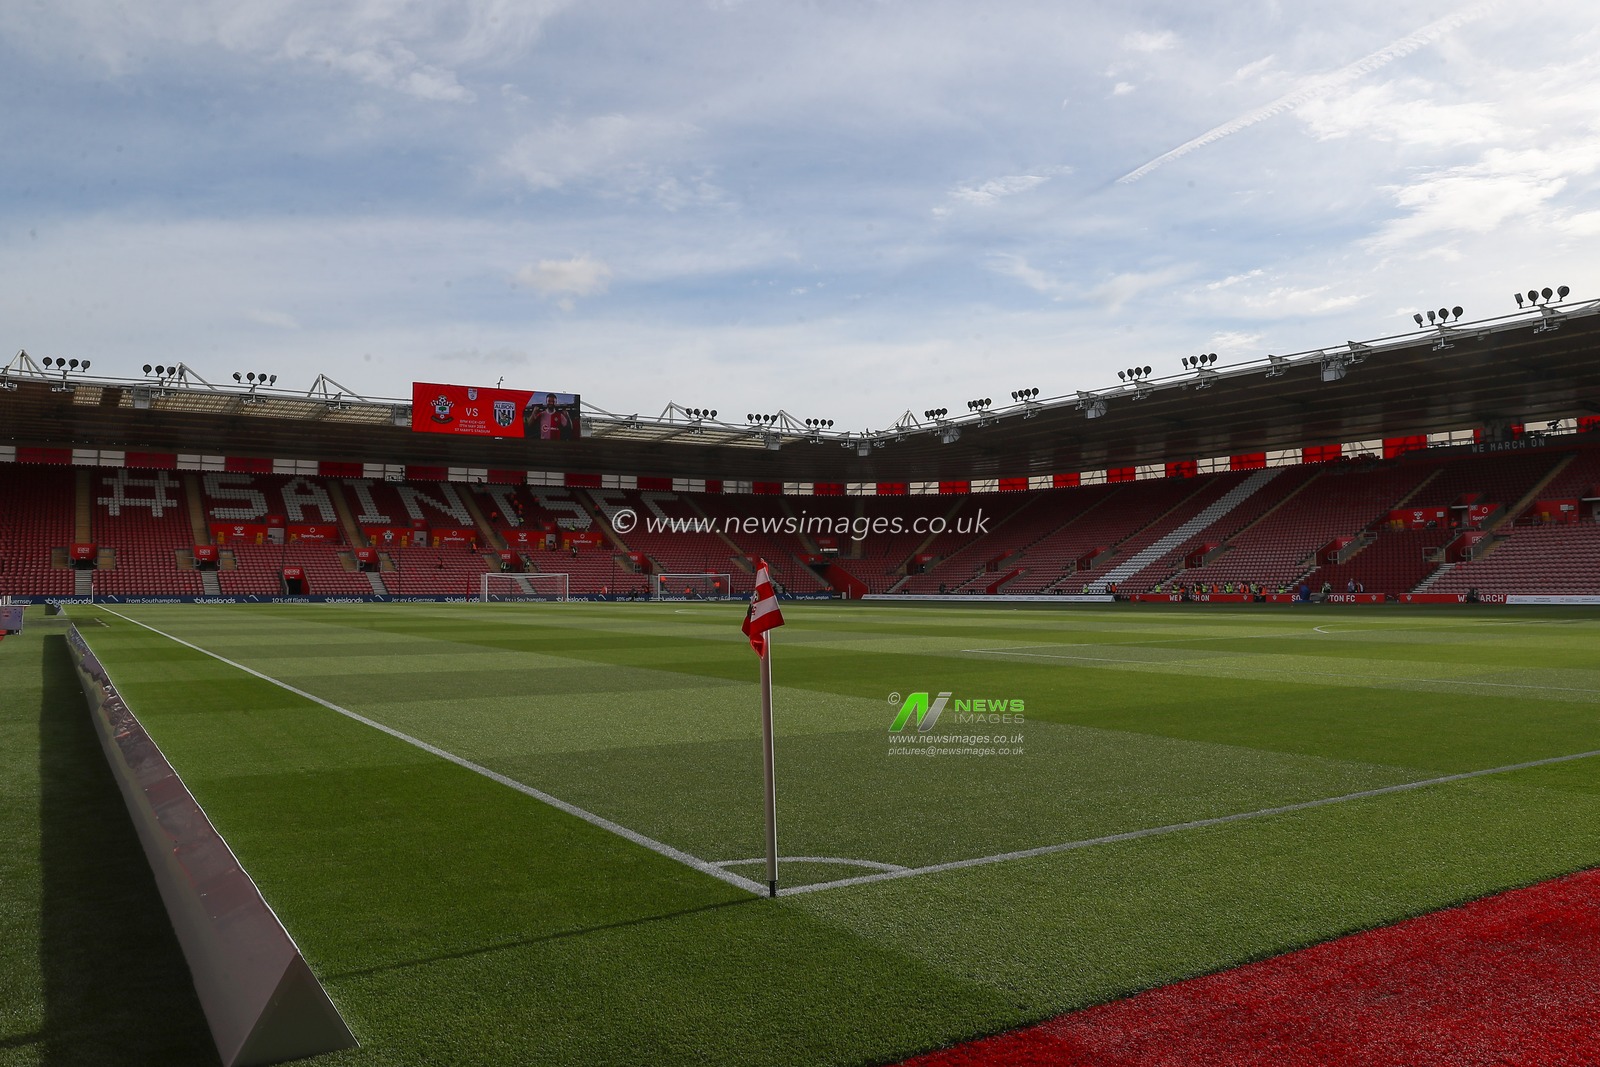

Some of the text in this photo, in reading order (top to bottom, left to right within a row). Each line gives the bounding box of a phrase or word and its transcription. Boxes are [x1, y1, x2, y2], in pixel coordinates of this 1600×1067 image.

[466, 408, 478, 416] VS
[1472, 438, 1545, 453] WE MARCH ON
